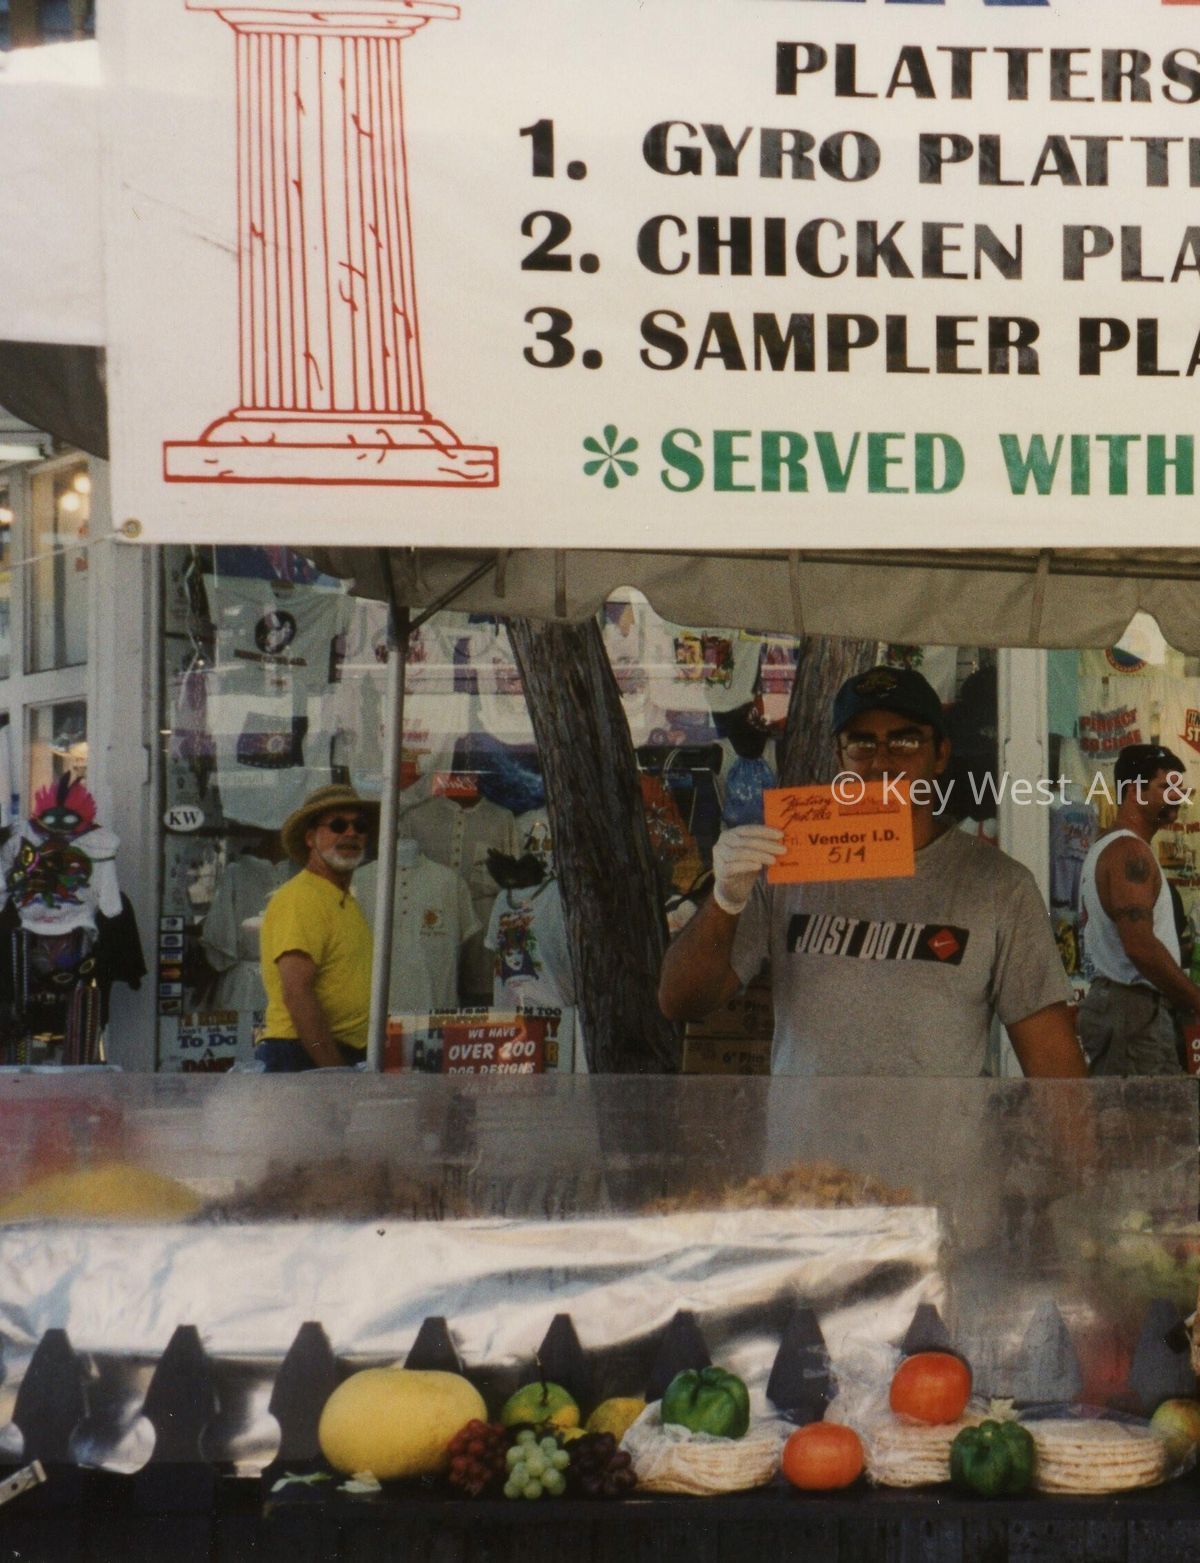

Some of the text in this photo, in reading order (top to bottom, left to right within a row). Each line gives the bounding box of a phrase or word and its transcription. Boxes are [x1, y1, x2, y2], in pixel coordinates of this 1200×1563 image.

[519, 119, 587, 181] 1.
[642, 121, 881, 182] GYRO
[520, 210, 600, 274] 2.
[637, 214, 1023, 280] CHICKEN
[523, 306, 603, 370] 3.
[639, 309, 1040, 375] SAMPLER
[661, 428, 965, 493] SERVED
[999, 434, 1194, 495] WITH
[169, 811, 200, 826] KW
[808, 832, 867, 847] Vendor
[872, 829, 900, 843] I.D.
[795, 914, 926, 960] JUST DO IT
[535, 1007, 561, 1017] TOO
[178, 1033, 238, 1049] To Do
[468, 1026, 517, 1040] WE HAVE
[448, 1043, 495, 1061] OVER
[479, 1061, 536, 1074] DESIGNS
